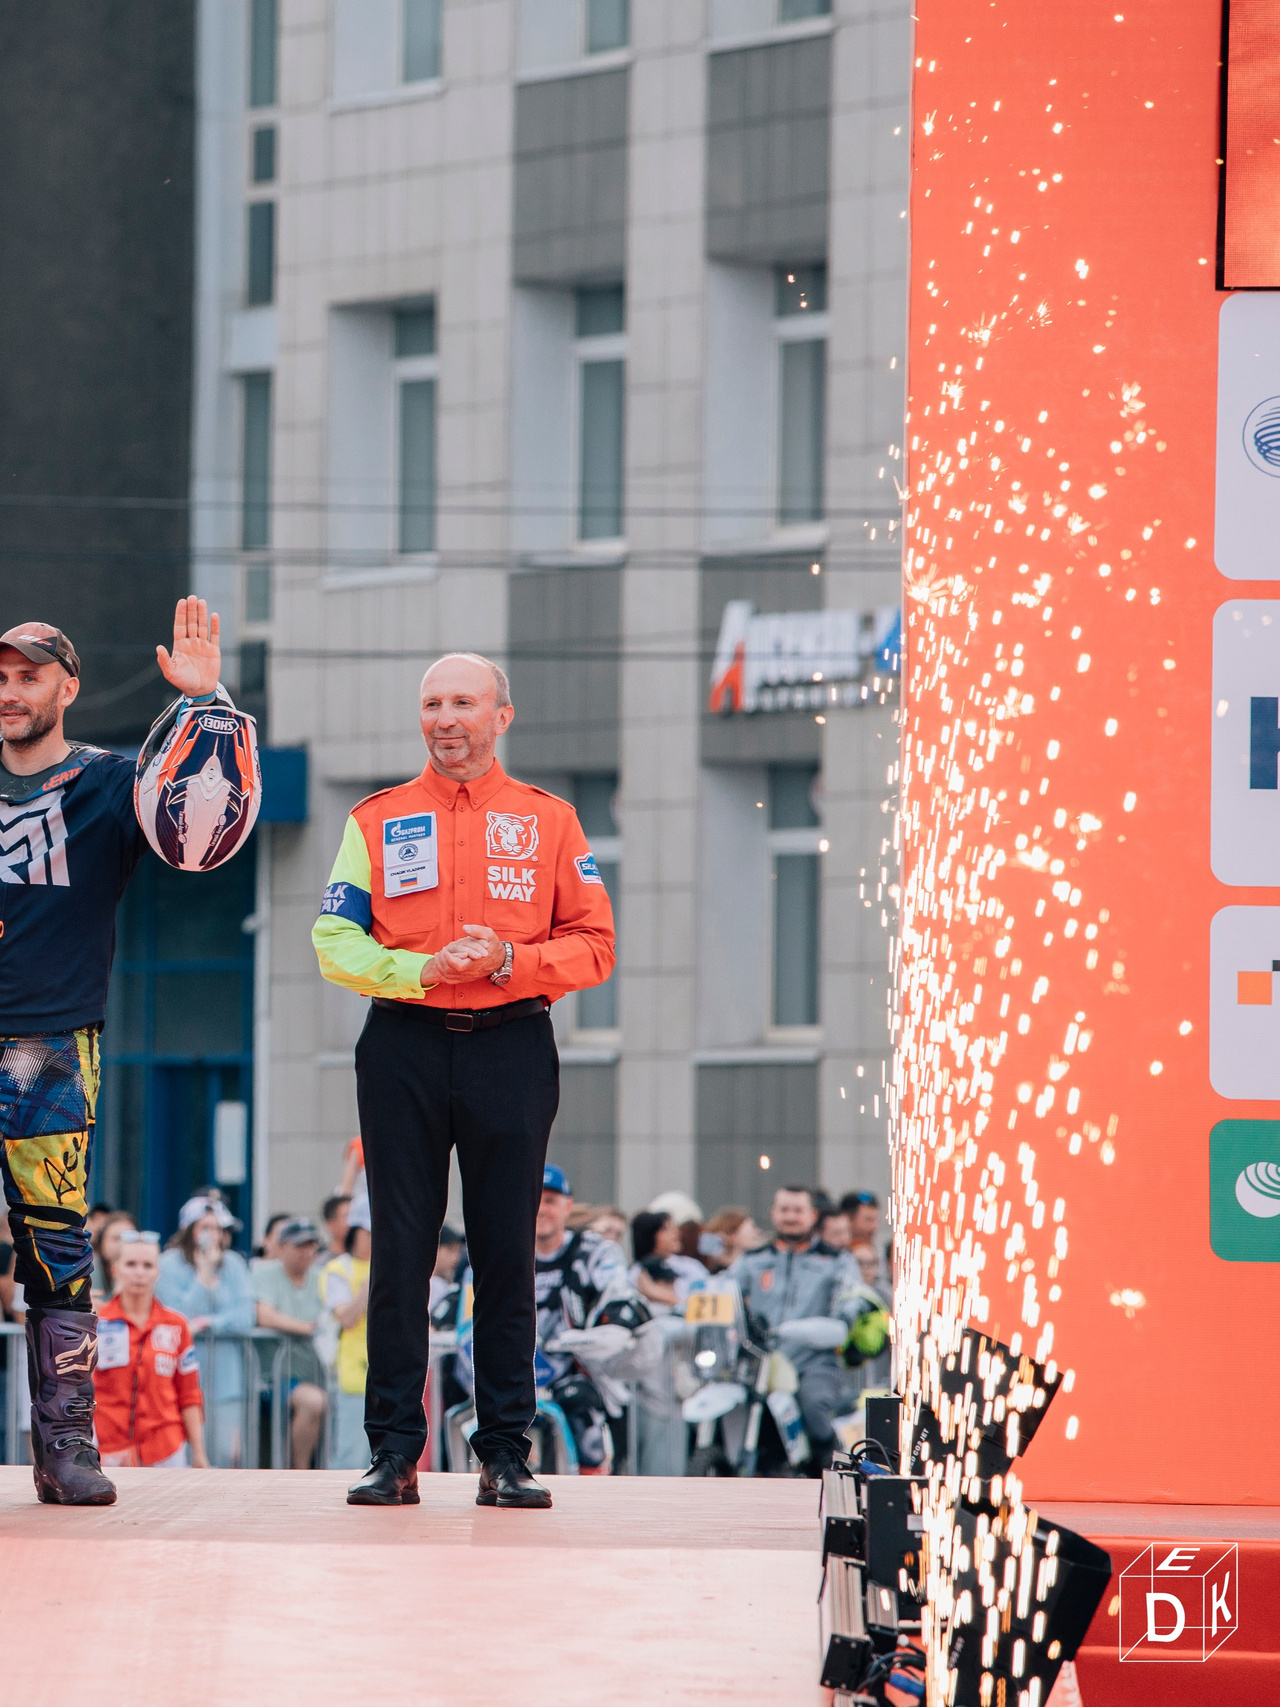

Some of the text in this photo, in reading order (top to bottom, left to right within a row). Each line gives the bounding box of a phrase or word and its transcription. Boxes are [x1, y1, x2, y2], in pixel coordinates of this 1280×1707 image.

[203, 717, 235, 732] SHOEI
[390, 835, 408, 843] GENERAL
[487, 865, 537, 886] SILK
[487, 882, 537, 903] WAY
[321, 898, 346, 913] AY
[695, 1294, 719, 1319] 21
[919, 1427, 930, 1444] JET
